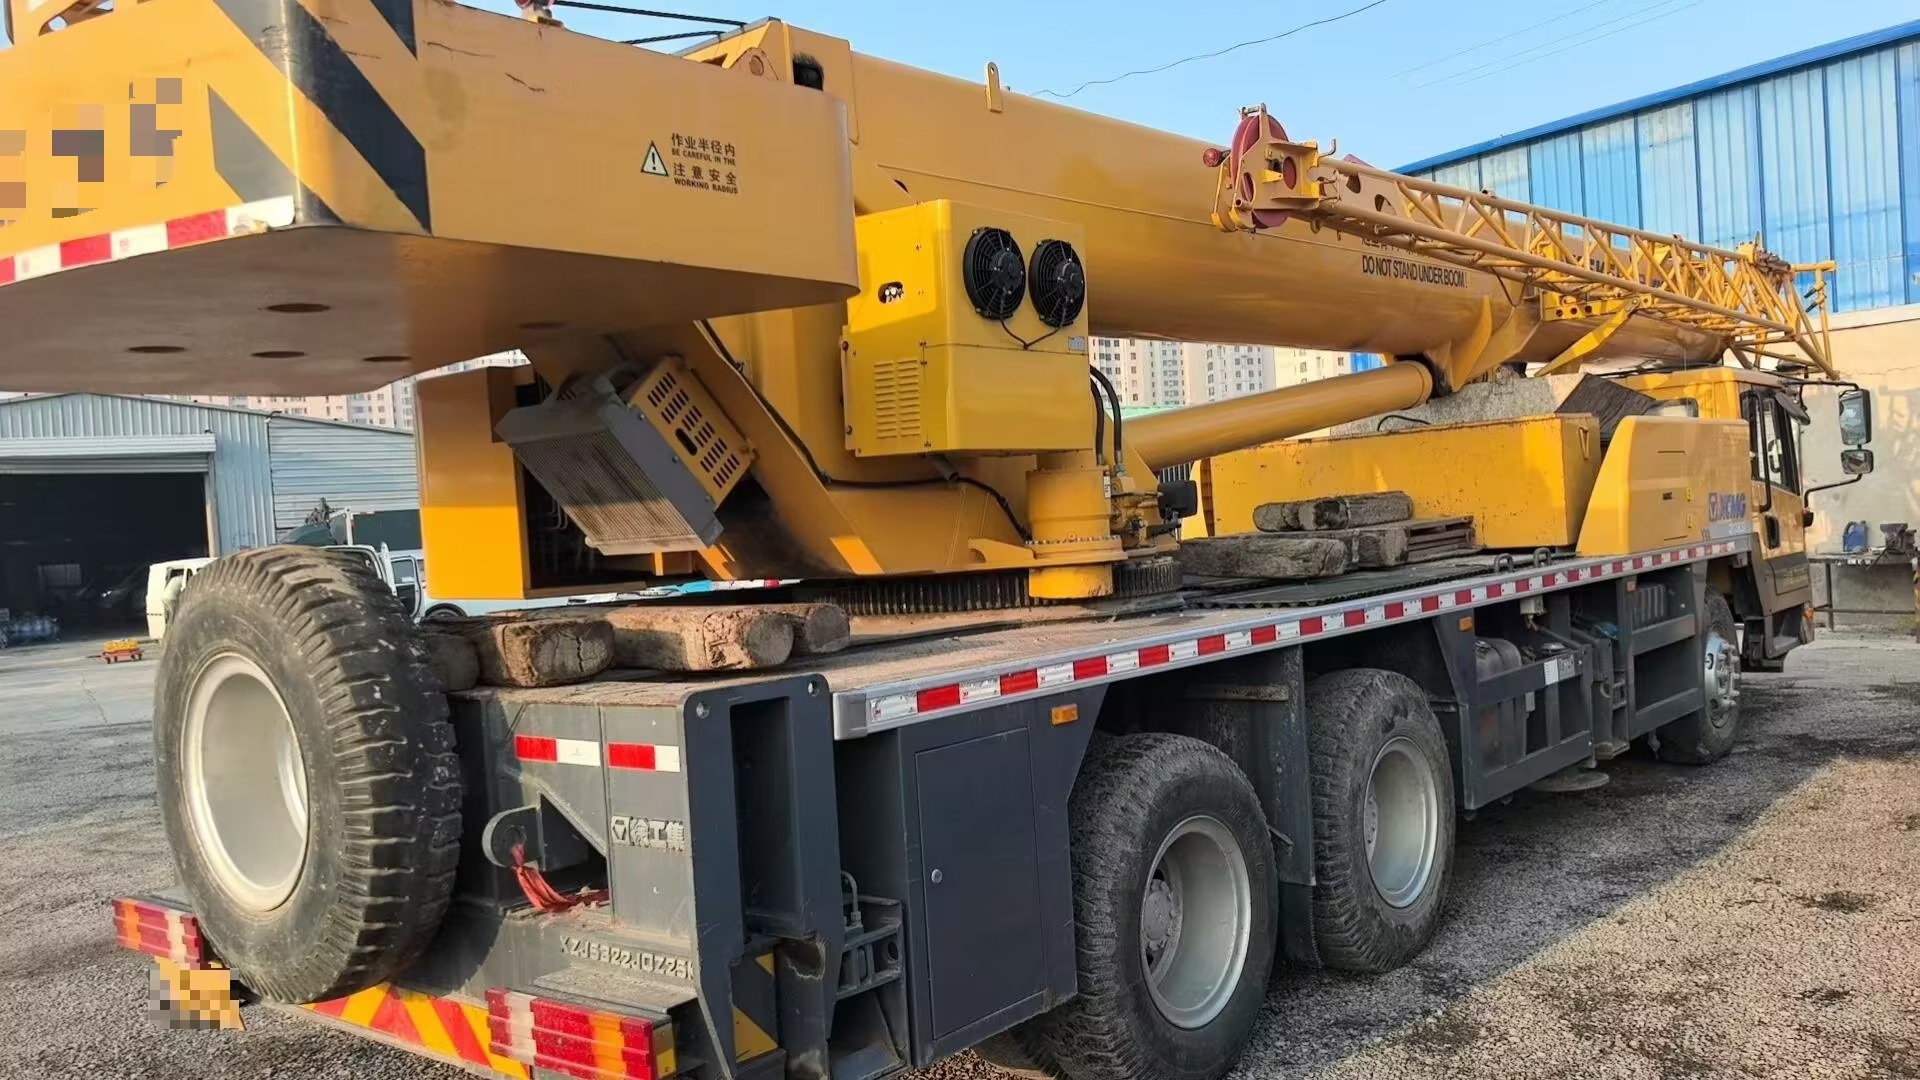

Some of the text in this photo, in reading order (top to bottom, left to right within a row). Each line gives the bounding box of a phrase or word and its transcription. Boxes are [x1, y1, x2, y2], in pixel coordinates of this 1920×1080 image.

[671, 133, 735, 157] 作业半径内
[672, 148, 680, 156] BE
[683, 149, 712, 161] CAREFUL
[724, 158, 736, 166] THE
[674, 162, 736, 186] 注意安全
[674, 177, 738, 194] WORKING RADIUS
[1362, 255, 1374, 273] DO
[1376, 258, 1392, 276] NOT
[1393, 260, 1418, 281] STAND
[1419, 265, 1444, 285] UNDER
